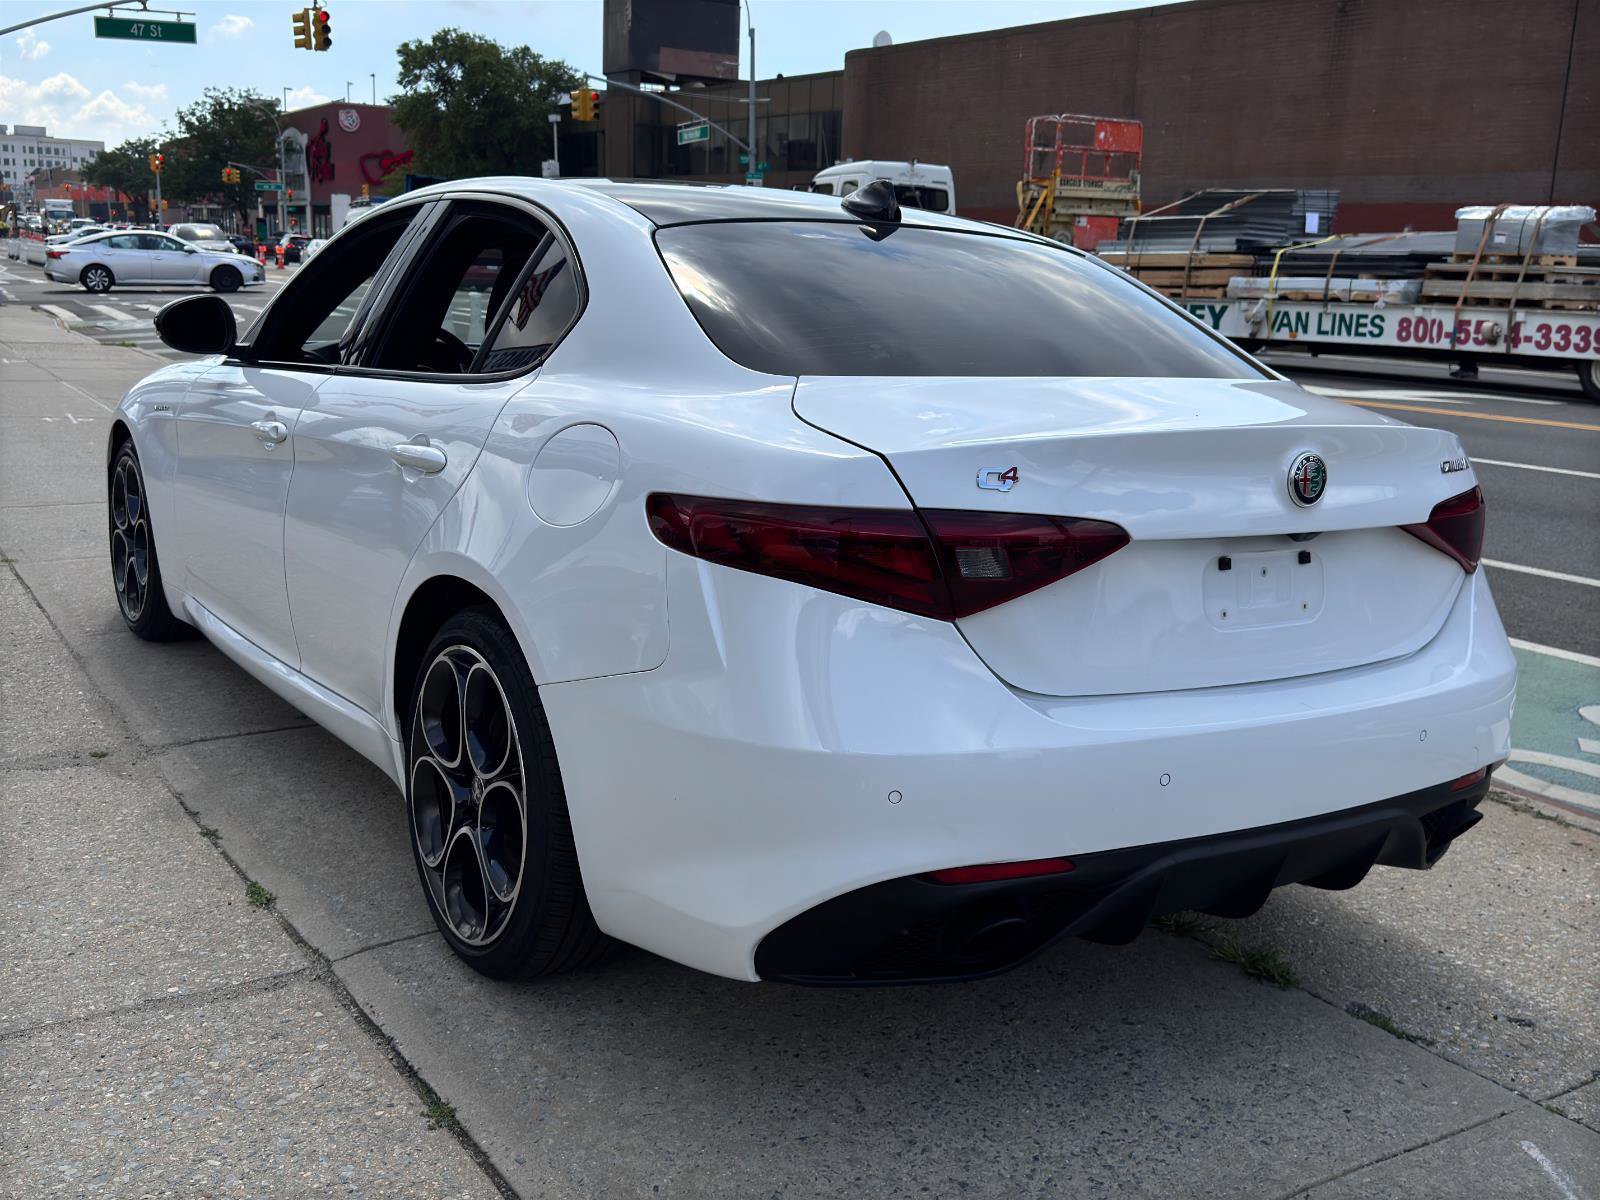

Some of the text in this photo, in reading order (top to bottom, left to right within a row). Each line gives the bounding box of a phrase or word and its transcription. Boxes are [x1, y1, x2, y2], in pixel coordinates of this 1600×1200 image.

[130, 23, 163, 38] 47 St
[1266, 310, 1309, 336] VAN
[1316, 312, 1385, 338] LINES
[976, 465, 1019, 493] Q4
